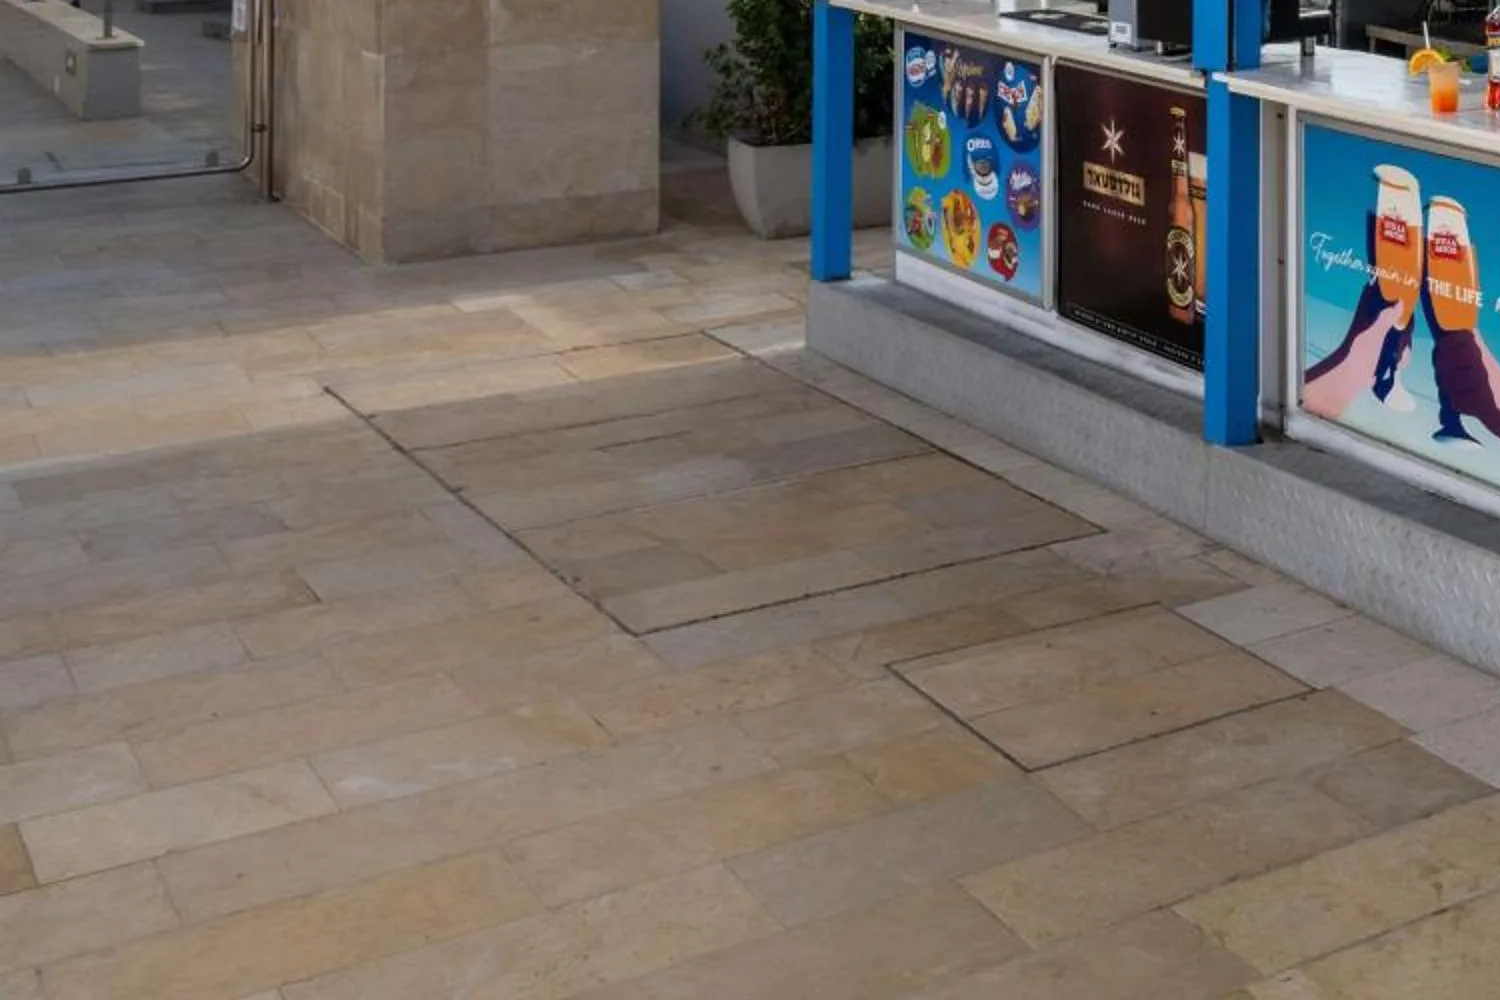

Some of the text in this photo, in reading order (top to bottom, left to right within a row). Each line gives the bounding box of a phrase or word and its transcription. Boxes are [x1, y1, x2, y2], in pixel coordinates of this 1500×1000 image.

[1309, 231, 1362, 270] Together
[1426, 277, 1453, 299] THE
[1455, 285, 1484, 308] LIFE
